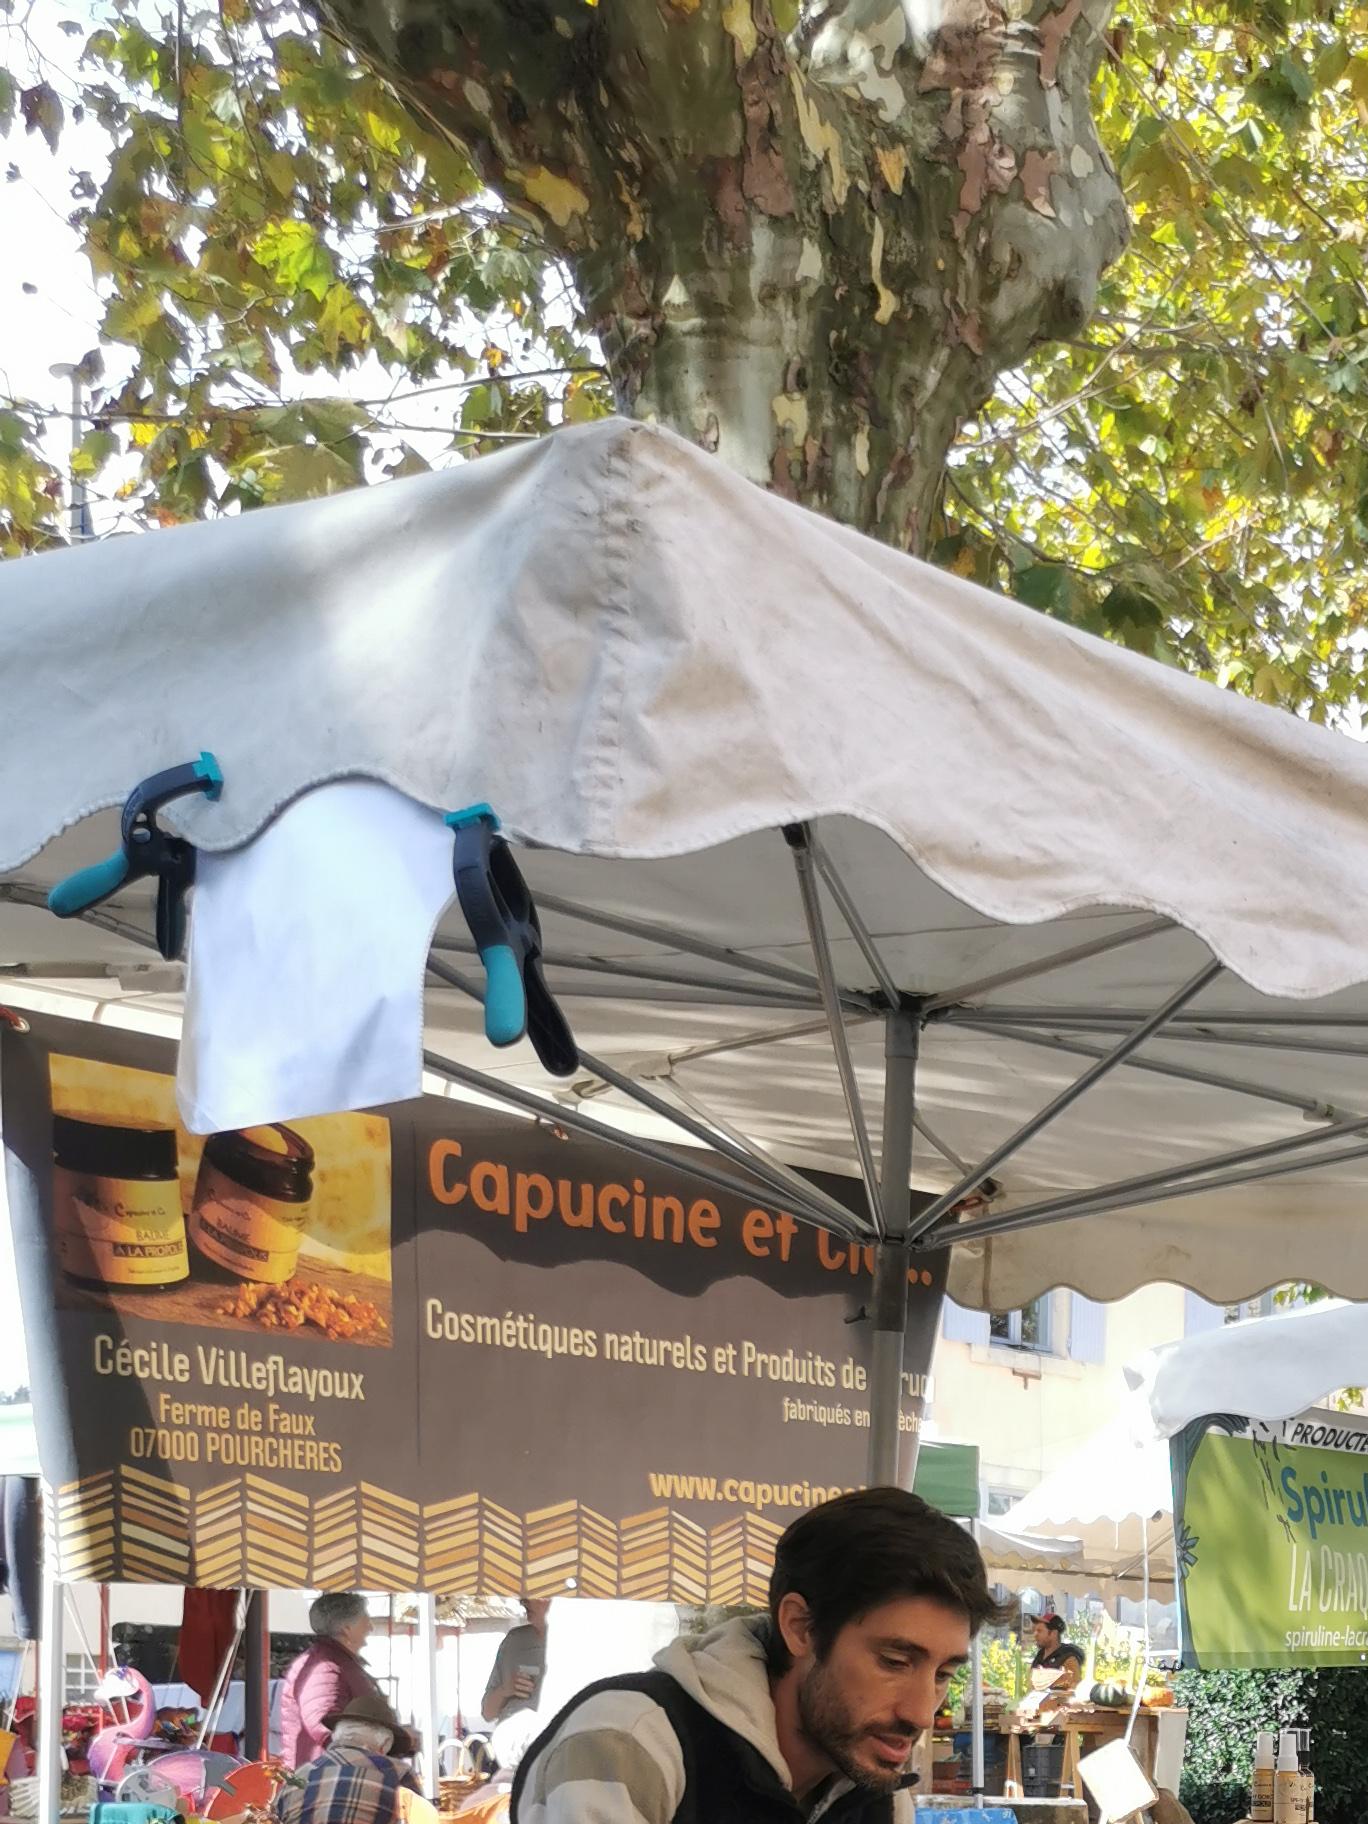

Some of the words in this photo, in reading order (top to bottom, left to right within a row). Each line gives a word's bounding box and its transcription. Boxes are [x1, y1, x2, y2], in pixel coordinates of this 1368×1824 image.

[428, 1139, 721, 1247] Capucine
[742, 1207, 798, 1261] et
[95, 1335, 191, 1383] Cécile
[197, 1345, 365, 1401] Villeflayoux
[426, 1298, 598, 1359] Cosmétiques
[604, 1331, 707, 1372] naturels
[714, 1343, 737, 1376] et
[742, 1340, 836, 1388] Produits
[842, 1358, 867, 1391] de
[158, 1393, 231, 1429] Ferme
[237, 1402, 262, 1432] de
[269, 1403, 316, 1436] Faux
[782, 1397, 851, 1427] fabriqués
[855, 1409, 870, 1428] en
[130, 1428, 199, 1462] 07000
[206, 1432, 343, 1473] POURCHERES
